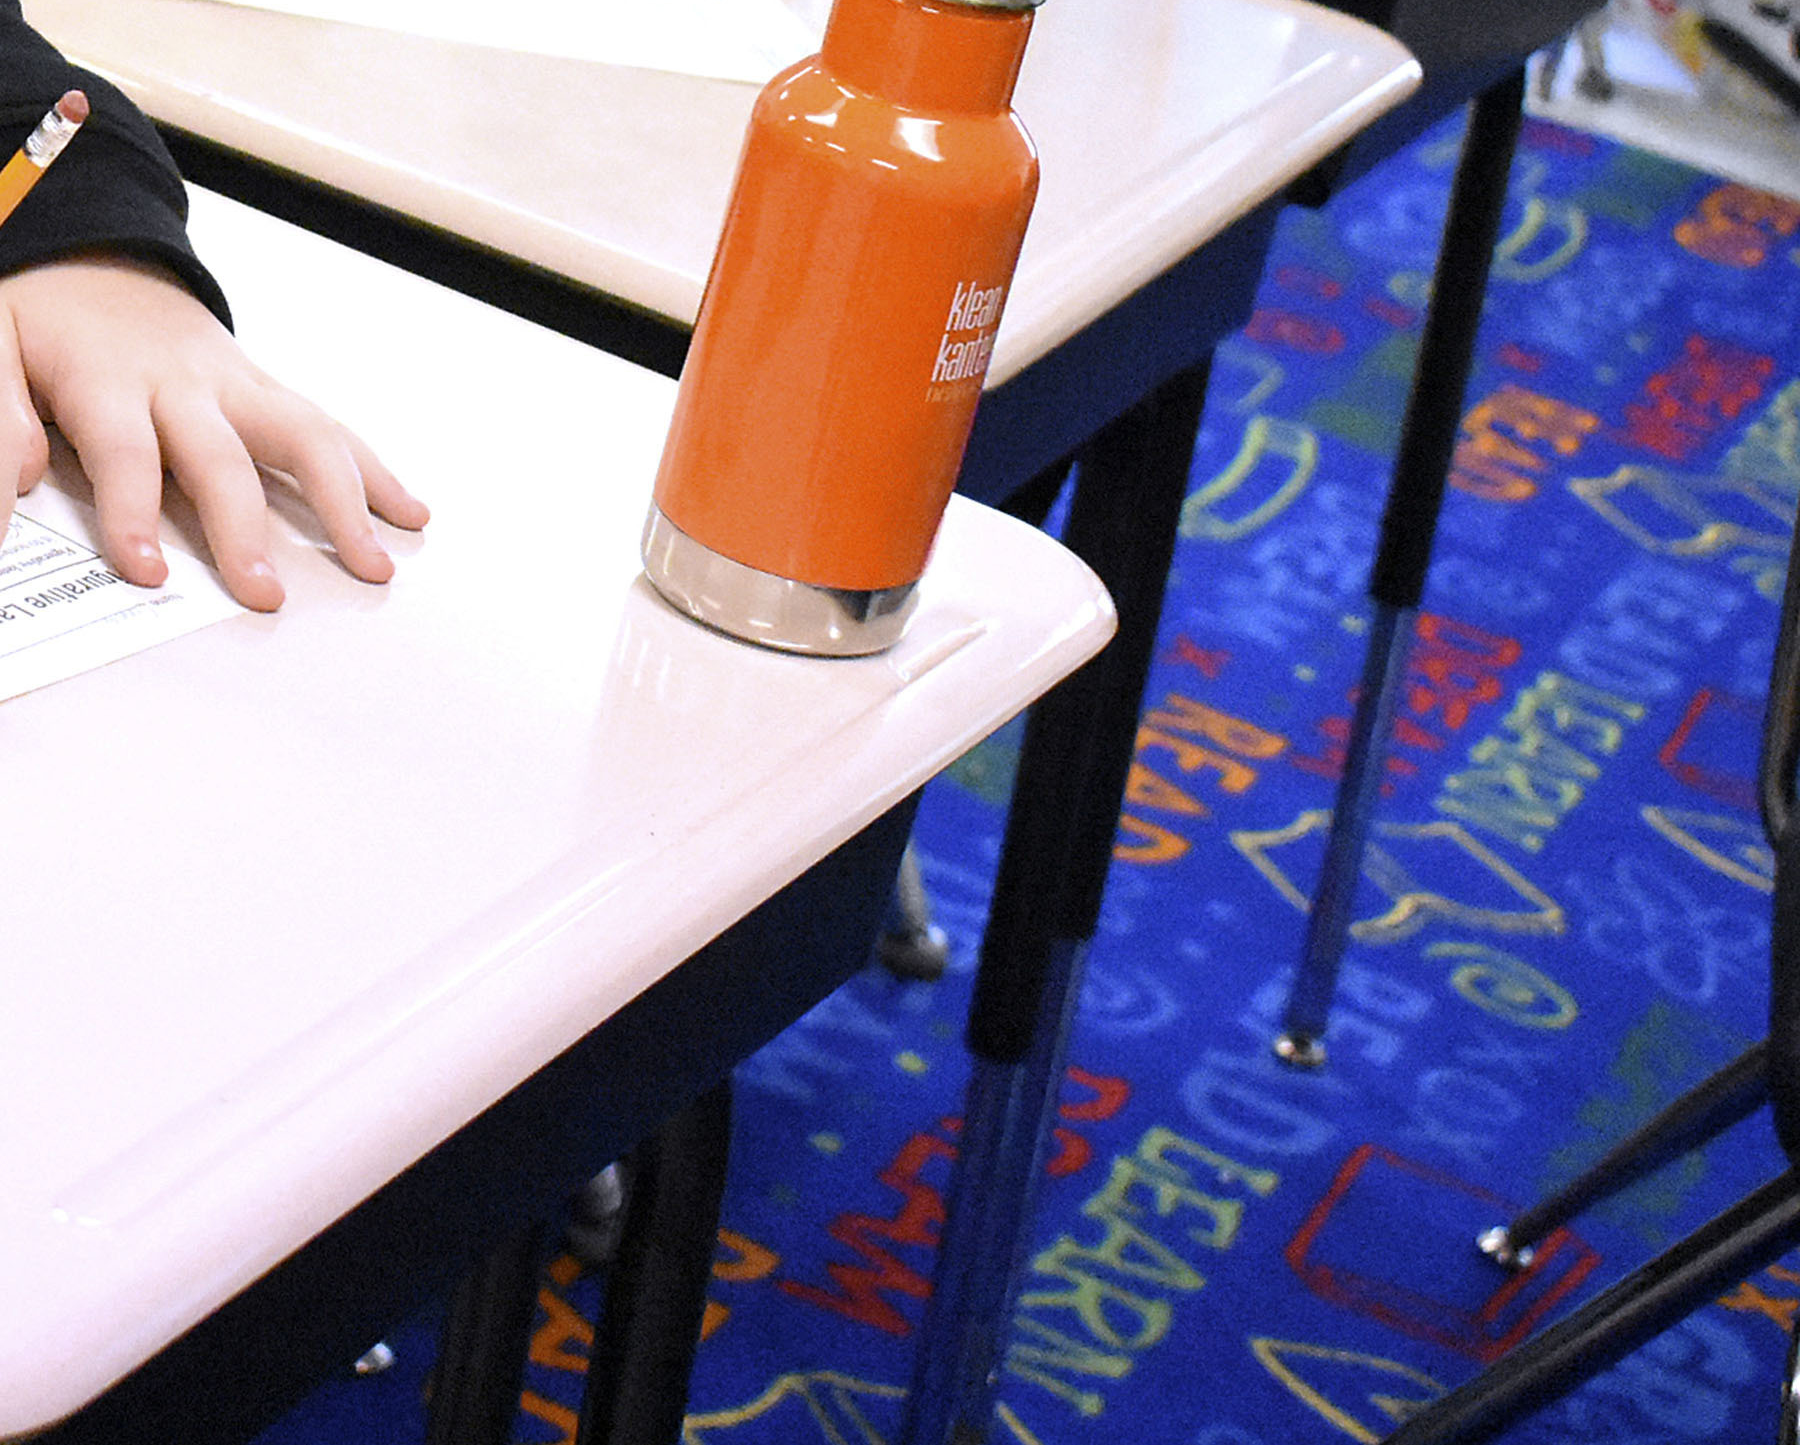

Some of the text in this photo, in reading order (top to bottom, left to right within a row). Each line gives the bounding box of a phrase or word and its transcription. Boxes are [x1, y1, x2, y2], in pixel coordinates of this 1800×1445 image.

[945, 280, 1003, 331] klean
[1113, 692, 1290, 864] READ
[1004, 1126, 1281, 1418] LEARN
